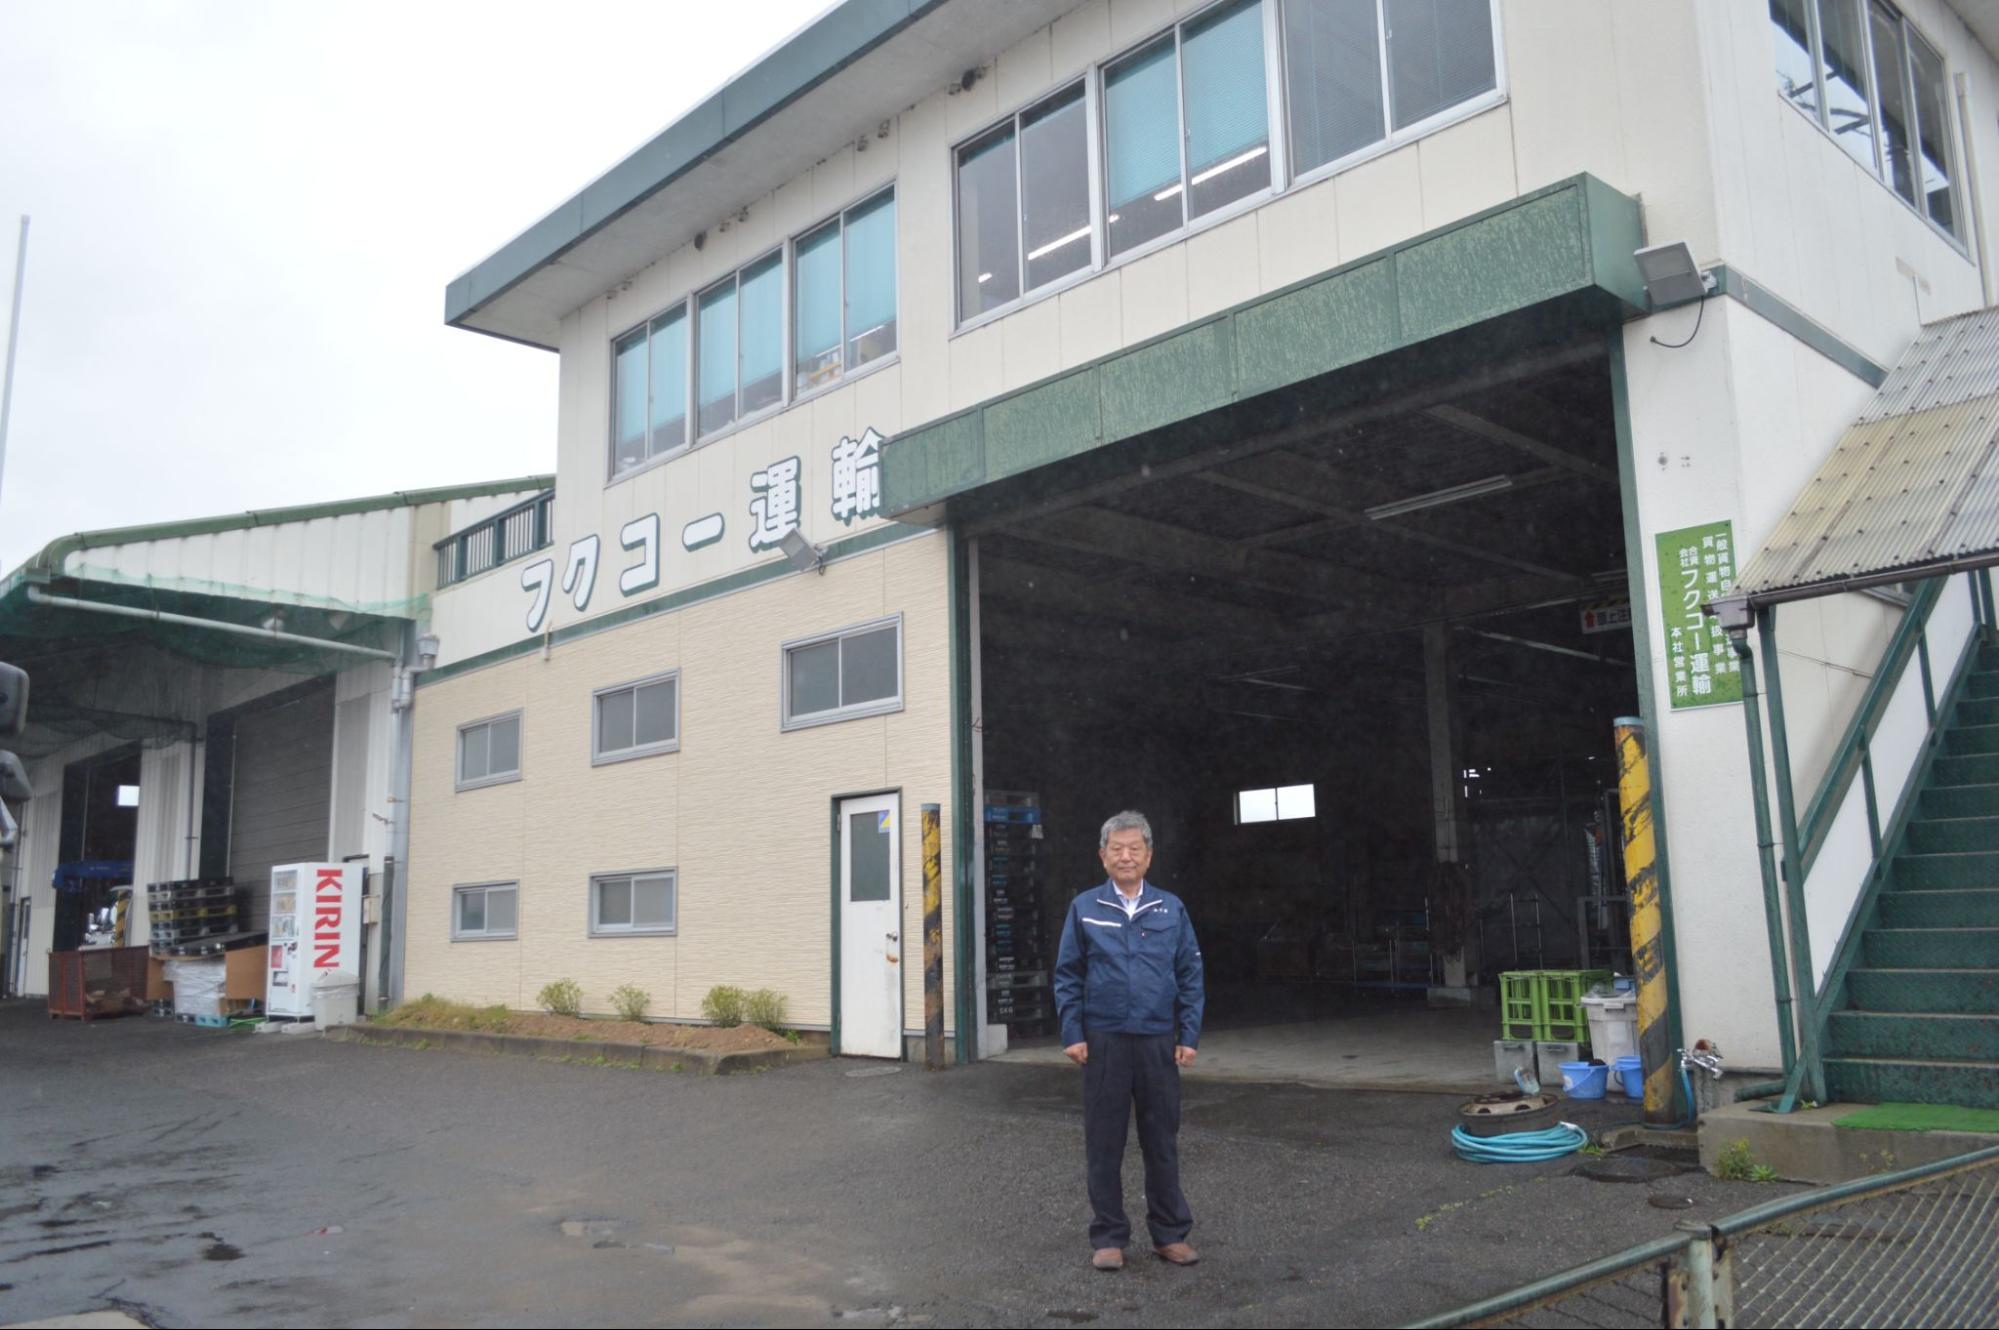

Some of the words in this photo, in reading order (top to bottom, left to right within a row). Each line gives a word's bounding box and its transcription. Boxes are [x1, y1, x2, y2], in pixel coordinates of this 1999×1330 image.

[521, 427, 884, 632] フクコー運輸
[1671, 627, 1688, 696] 本社営業所
[1681, 568, 1712, 695] フクコー運輸
[313, 869, 343, 968] KIRIN
